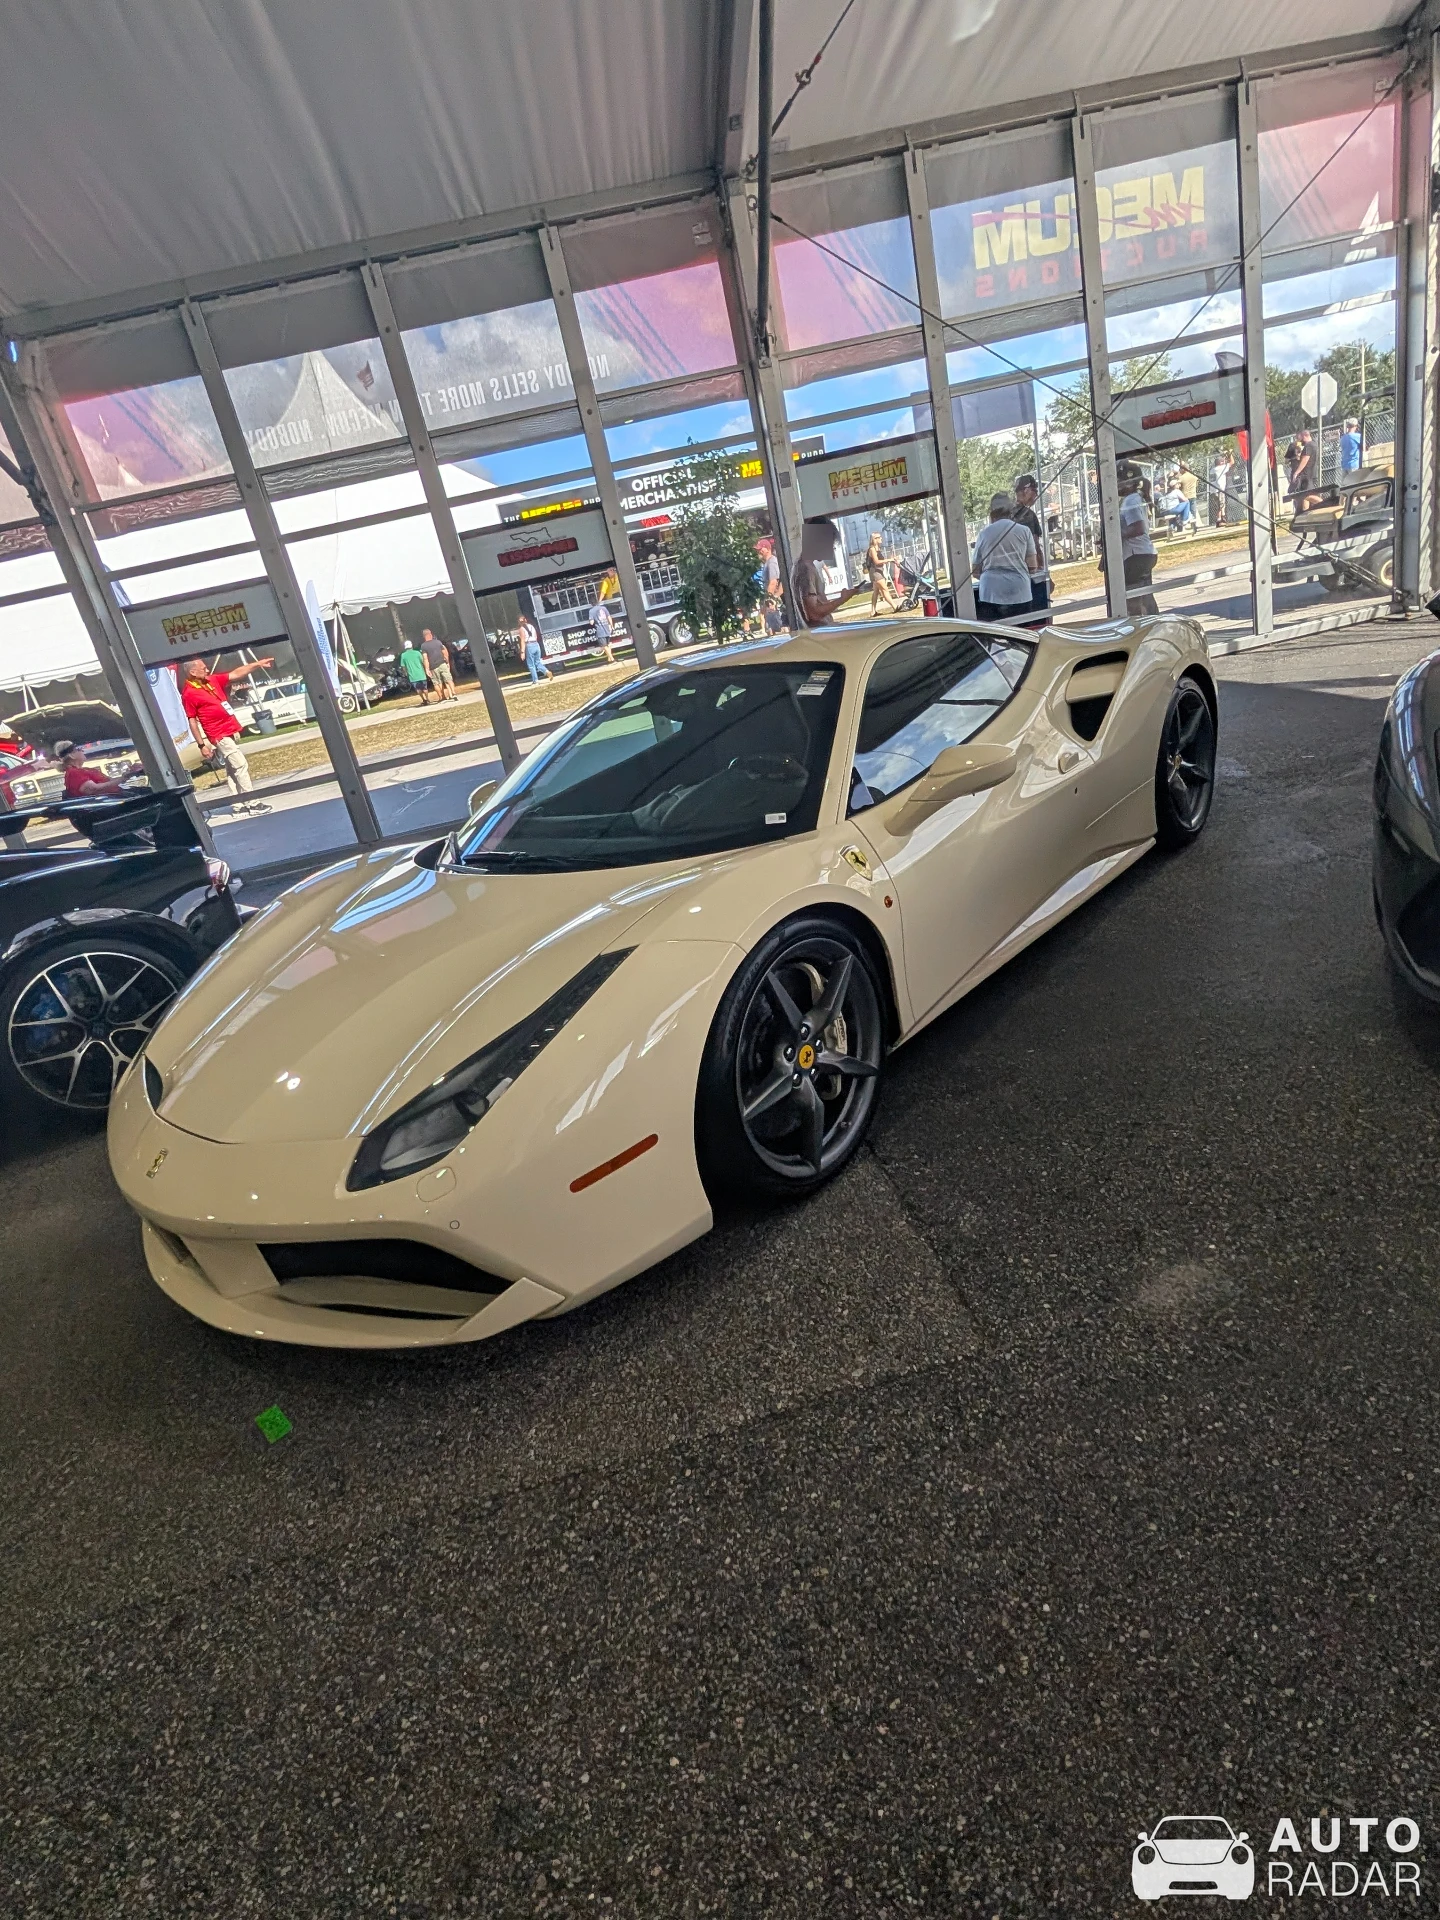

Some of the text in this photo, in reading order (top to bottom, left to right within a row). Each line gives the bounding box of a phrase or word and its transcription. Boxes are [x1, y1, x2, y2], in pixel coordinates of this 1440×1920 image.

[828, 456, 907, 491] MECUM
[832, 476, 909, 499] AUCTIONS
[161, 602, 249, 637] MECUM
[168, 621, 251, 645] AUCTIONS
[567, 630, 587, 640] SHOP
